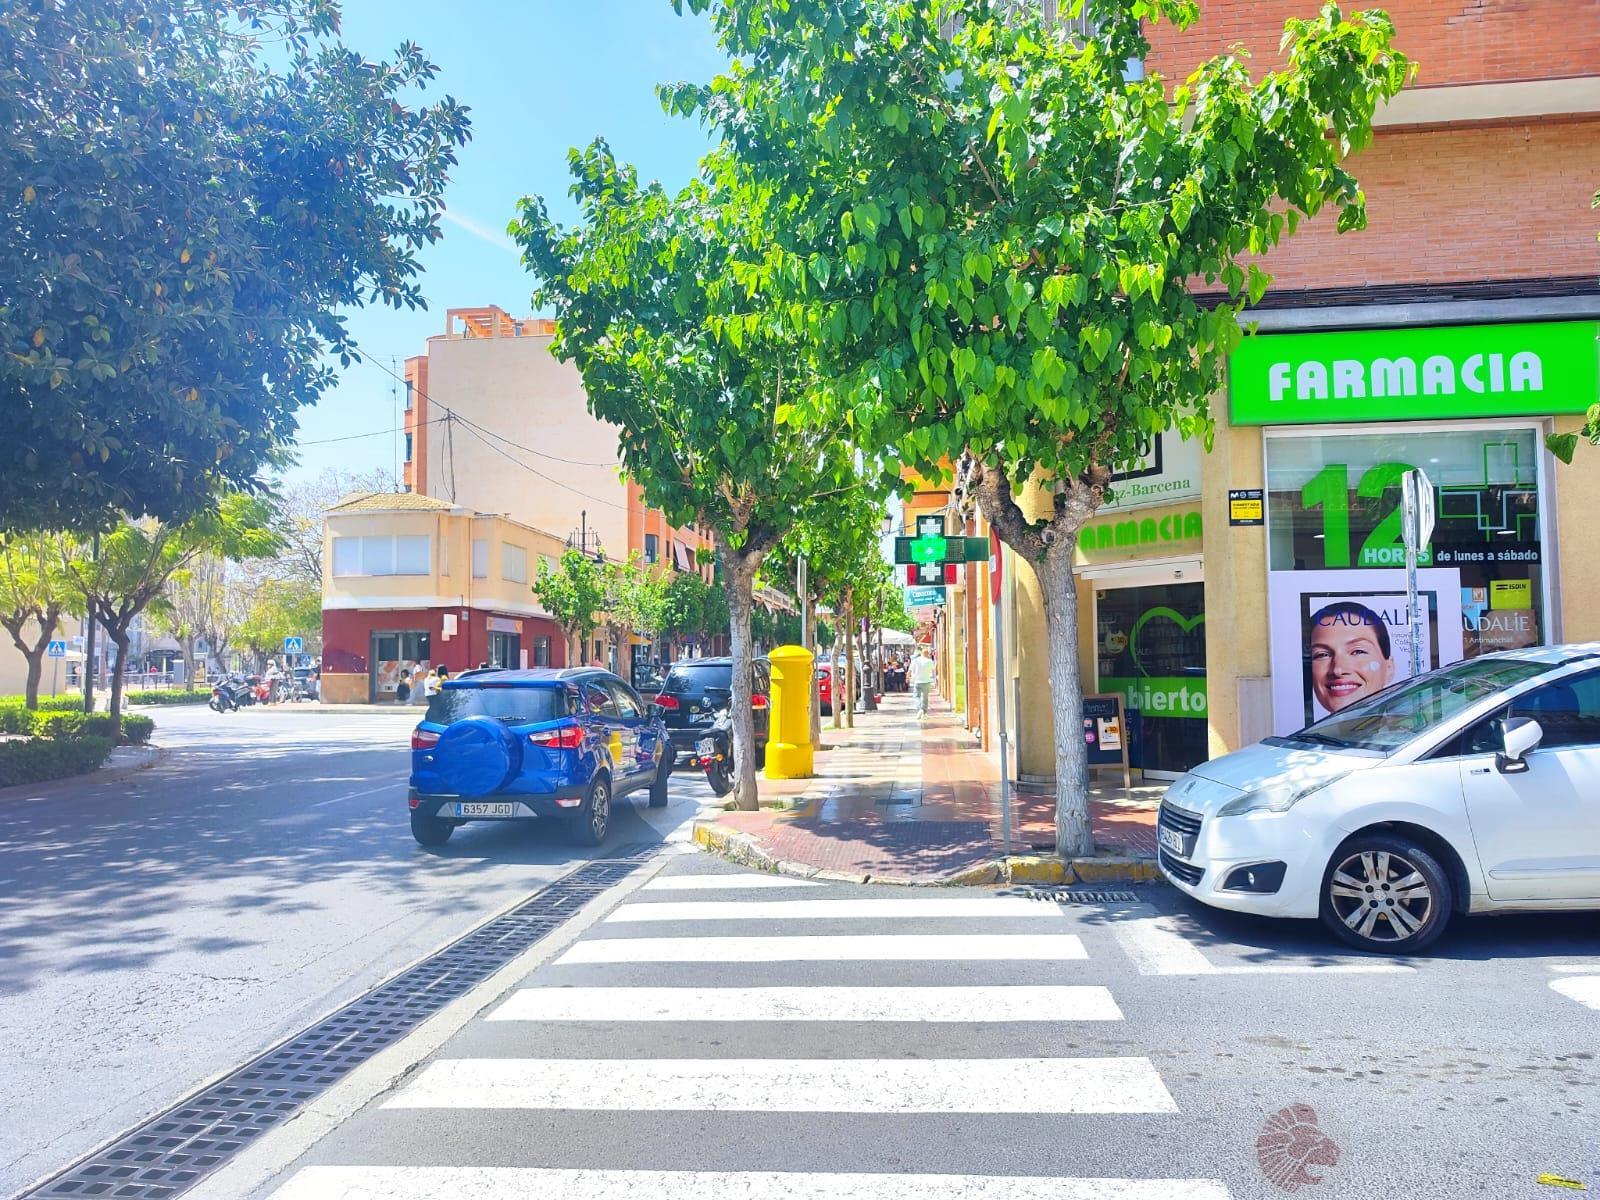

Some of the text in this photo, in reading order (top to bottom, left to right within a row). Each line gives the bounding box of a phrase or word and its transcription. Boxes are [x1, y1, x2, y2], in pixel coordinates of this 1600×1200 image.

[1268, 351, 1544, 401] FARMACIA
[1300, 462, 1434, 568] 12
[1079, 511, 1203, 551] ARMACIA
[1364, 547, 1430, 564] HORS
[1437, 549, 1538, 562] de lunes a sábado
[1123, 685, 1206, 712] bierto
[463, 804, 511, 814] 6357 JGD
